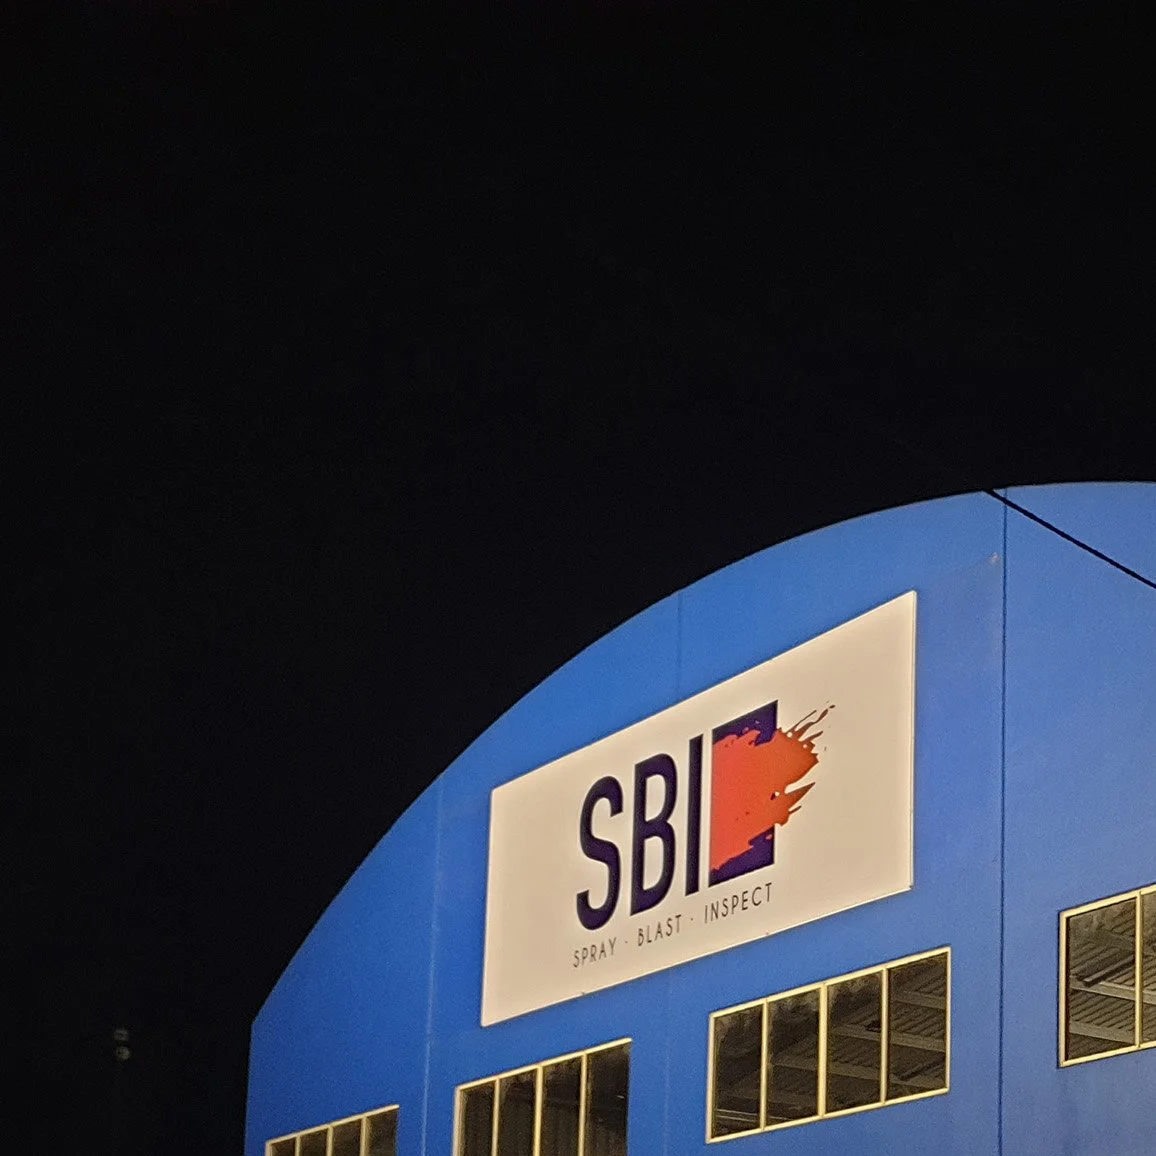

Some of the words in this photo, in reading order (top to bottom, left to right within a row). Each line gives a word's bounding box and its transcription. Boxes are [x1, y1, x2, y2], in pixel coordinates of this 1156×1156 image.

[576, 733, 704, 930] SBI
[573, 937, 616, 968] SPRAY
[637, 914, 681, 947] BLAST
[704, 882, 772, 924] INSPECT
